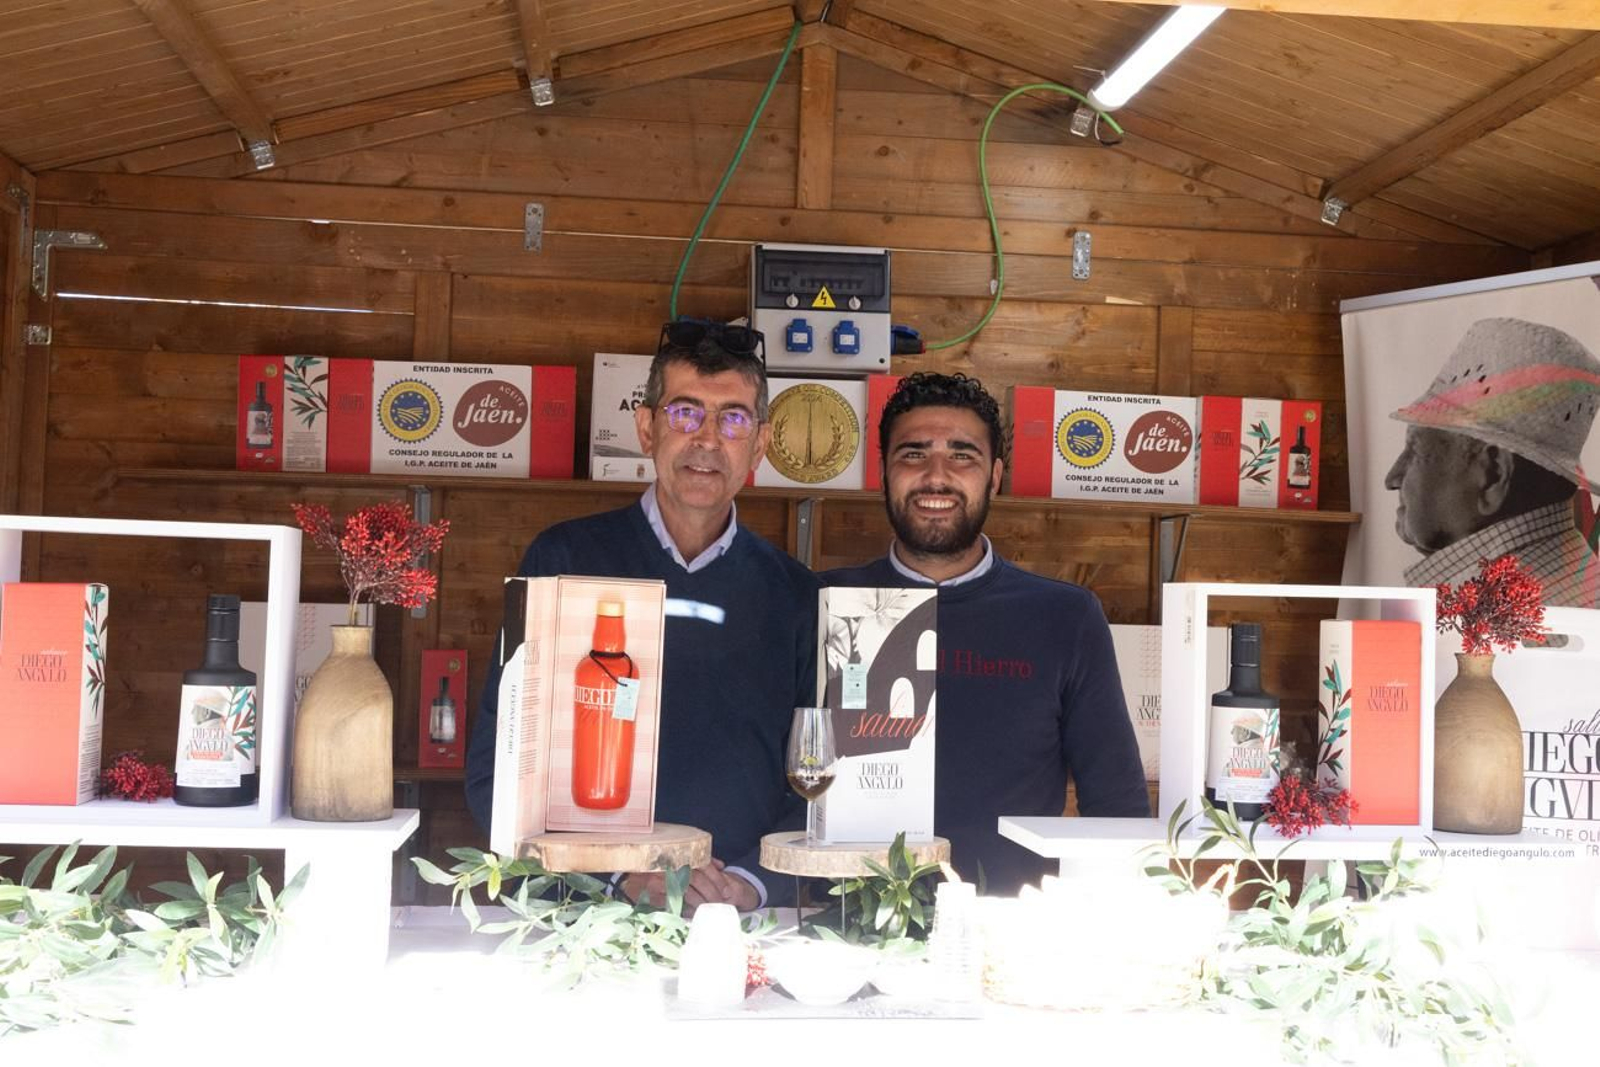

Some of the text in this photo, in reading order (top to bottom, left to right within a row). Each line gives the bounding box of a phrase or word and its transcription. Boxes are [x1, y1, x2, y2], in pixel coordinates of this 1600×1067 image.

[413, 365, 451, 373] ENTIDAD
[480, 394, 498, 408] de
[499, 385, 525, 407] ACEITE
[1087, 395, 1161, 405] ENTIDAD INSCRITA
[1149, 423, 1166, 437] de
[1166, 415, 1190, 436] ACEITE
[389, 449, 430, 457] CONSEJO
[1065, 474, 1103, 483] CONSEJO
[1104, 476, 1153, 485] REGULADOR
[1101, 486, 1129, 494] ACEITE
[21, 653, 63, 668] DIEGO
[1369, 686, 1405, 699] DIEGO
[1141, 694, 1161, 707] DIE
[192, 728, 224, 739] DIEGO
[861, 762, 899, 776] DIEGO
[1419, 847, 1575, 861] www.aceitediegoangulo.com
